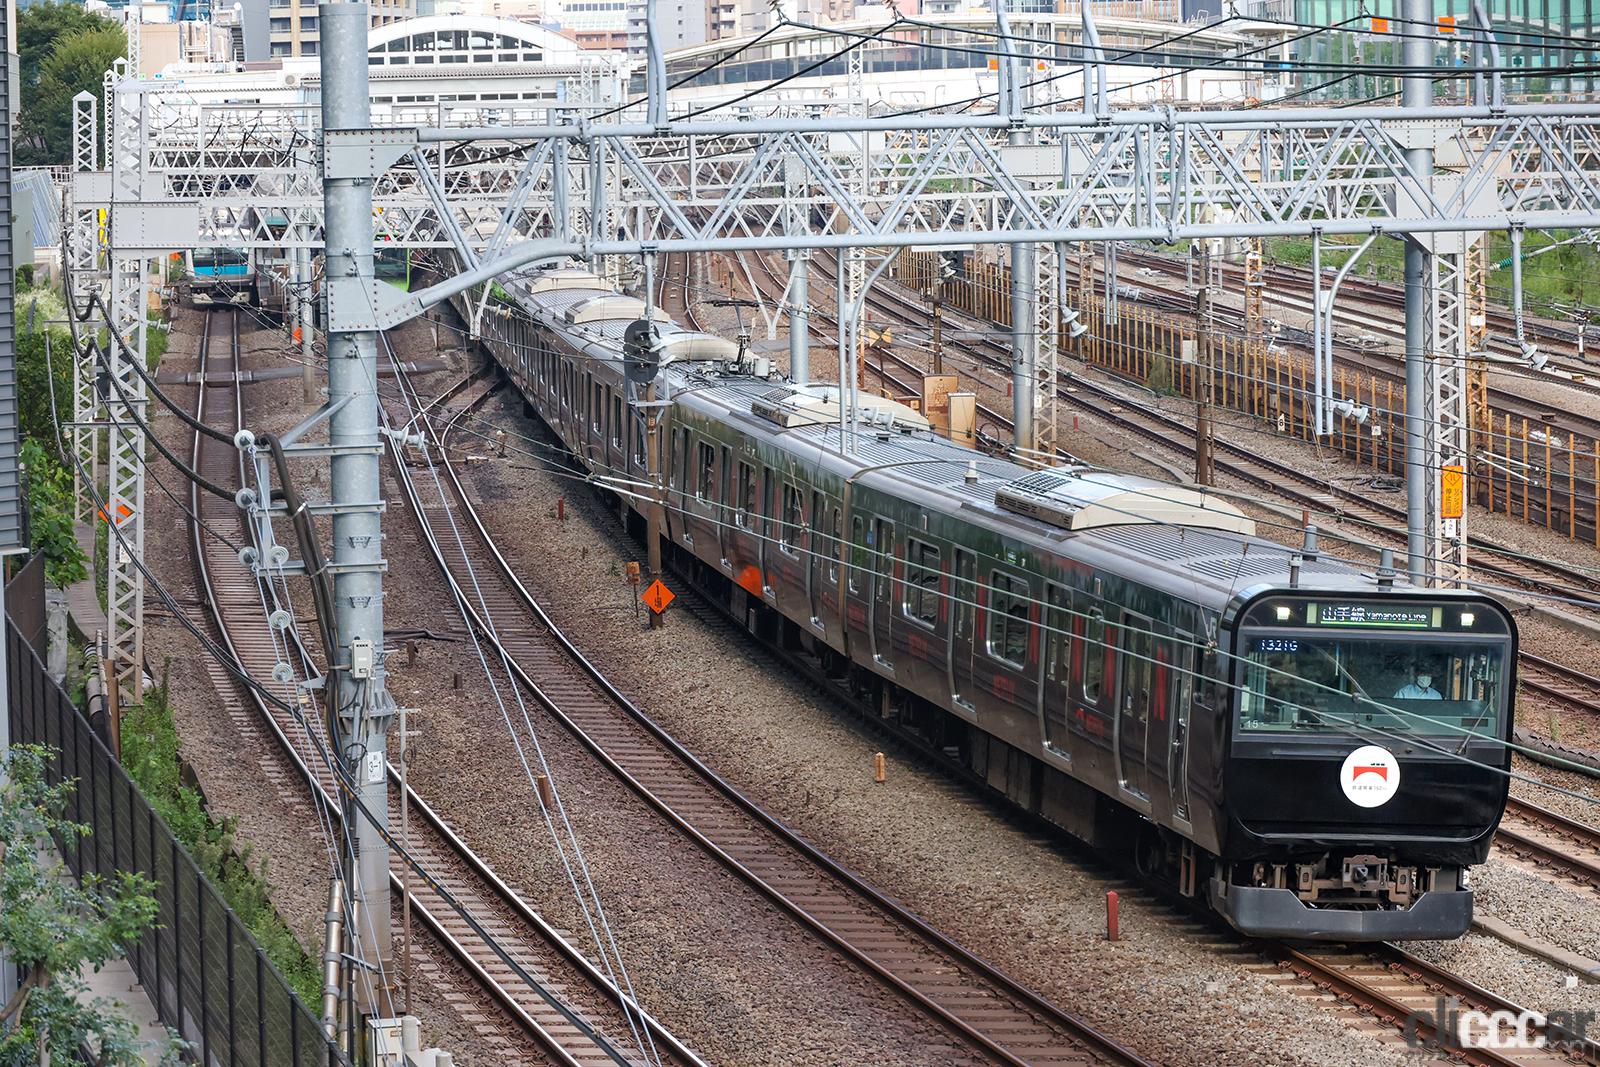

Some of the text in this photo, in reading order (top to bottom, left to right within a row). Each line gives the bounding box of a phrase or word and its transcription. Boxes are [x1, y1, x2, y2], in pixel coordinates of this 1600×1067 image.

[1323, 606, 1366, 622] 山手線
[1366, 611, 1427, 622] Yamanote Line
[1261, 639, 1298, 651] 1321G
